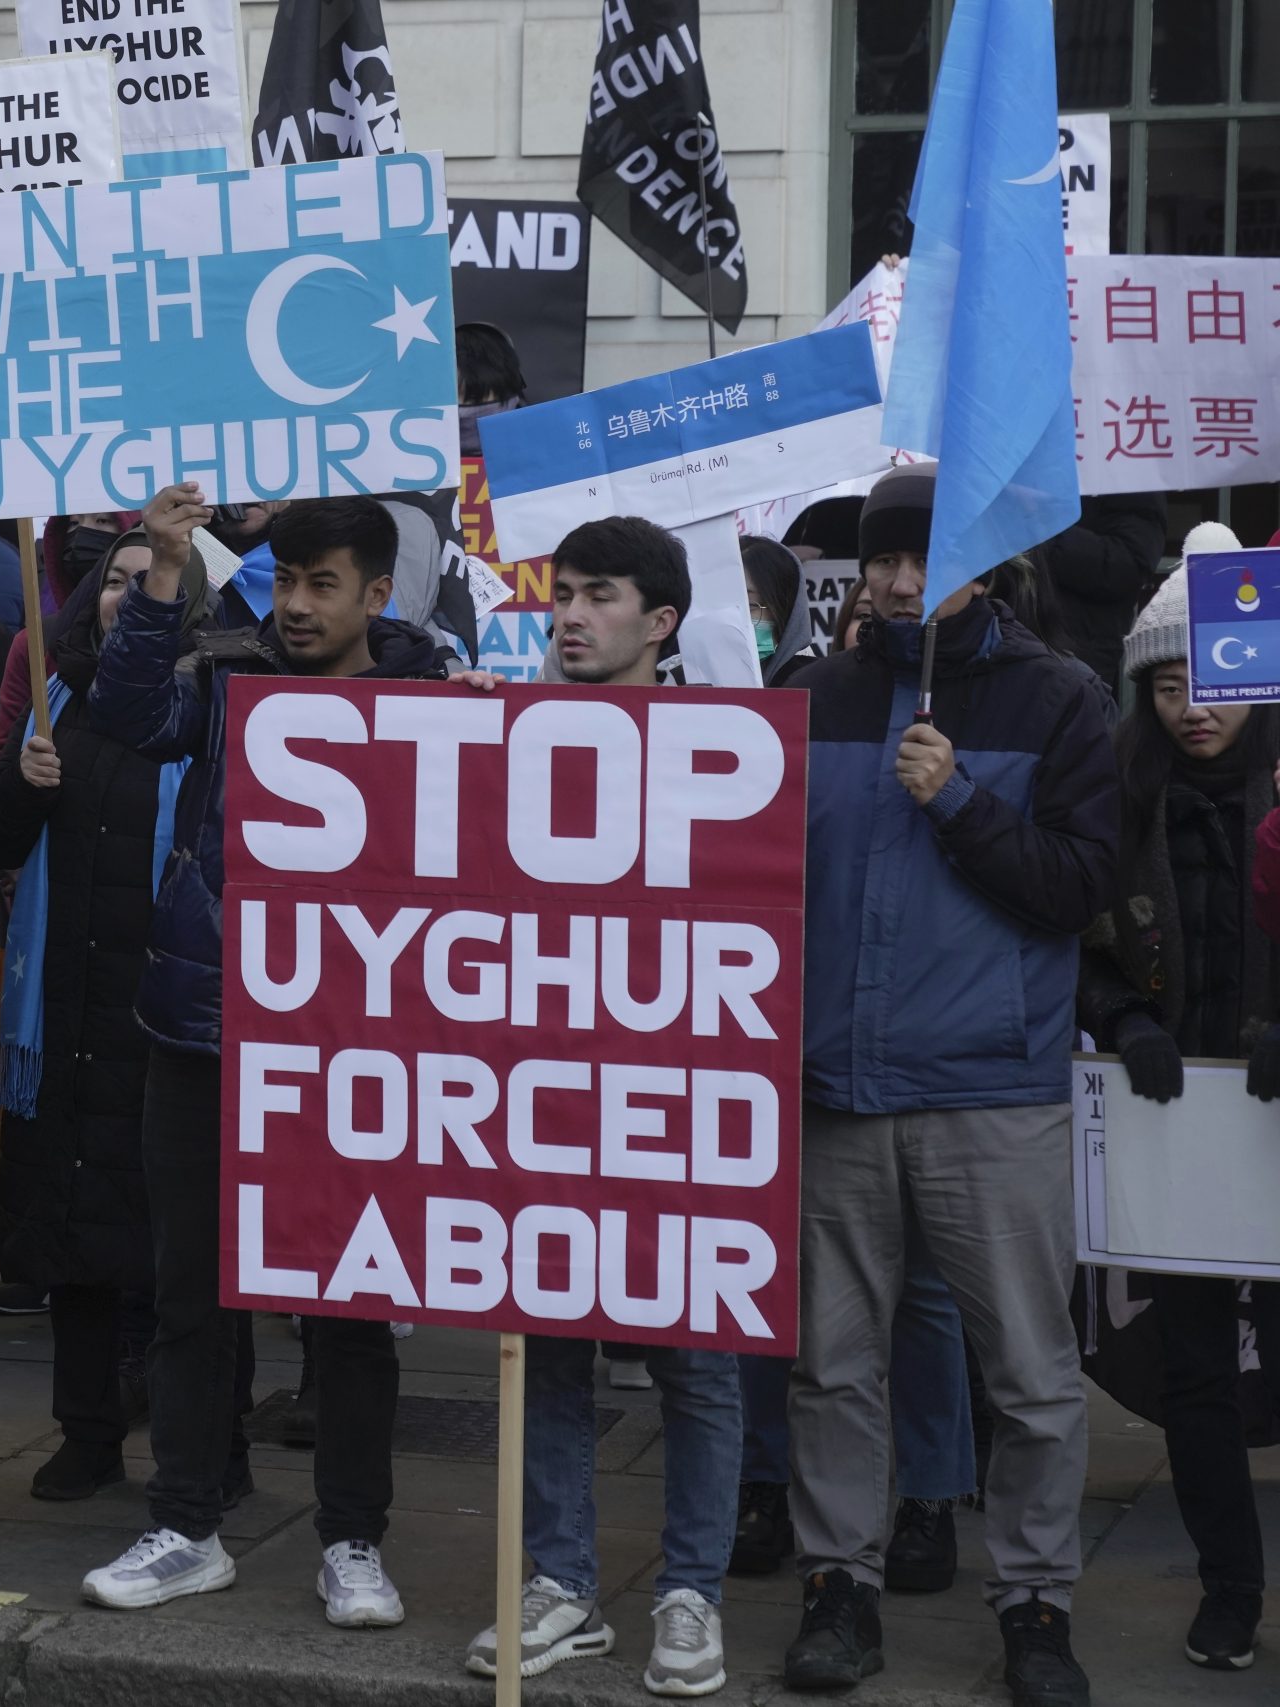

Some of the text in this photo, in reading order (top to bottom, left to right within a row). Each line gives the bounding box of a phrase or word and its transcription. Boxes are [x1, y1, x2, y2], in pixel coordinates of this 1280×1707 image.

[61, 0, 121, 24] END
[117, 72, 210, 104] OCIDE
[0, 91, 60, 123] THE
[762, 372, 777, 388] 南
[765, 389, 780, 402] 88
[607, 382, 749, 440] 乌鲁木齐中路
[575, 421, 590, 436] 北
[1070, 394, 1260, 462] 选票
[578, 438, 592, 450] 66
[777, 442, 785, 453] S
[649, 454, 729, 484] Ürümqi Rd. (M)
[588, 487, 597, 498] N
[1196, 689, 1220, 699] FREE
[1220, 688, 1238, 698] THE
[1239, 686, 1274, 697] PEOPLE
[242, 692, 786, 889] STOP
[240, 899, 781, 1041] UYGHUR
[238, 1041, 780, 1189] FORCED
[237, 1182, 778, 1341] LABOUR
